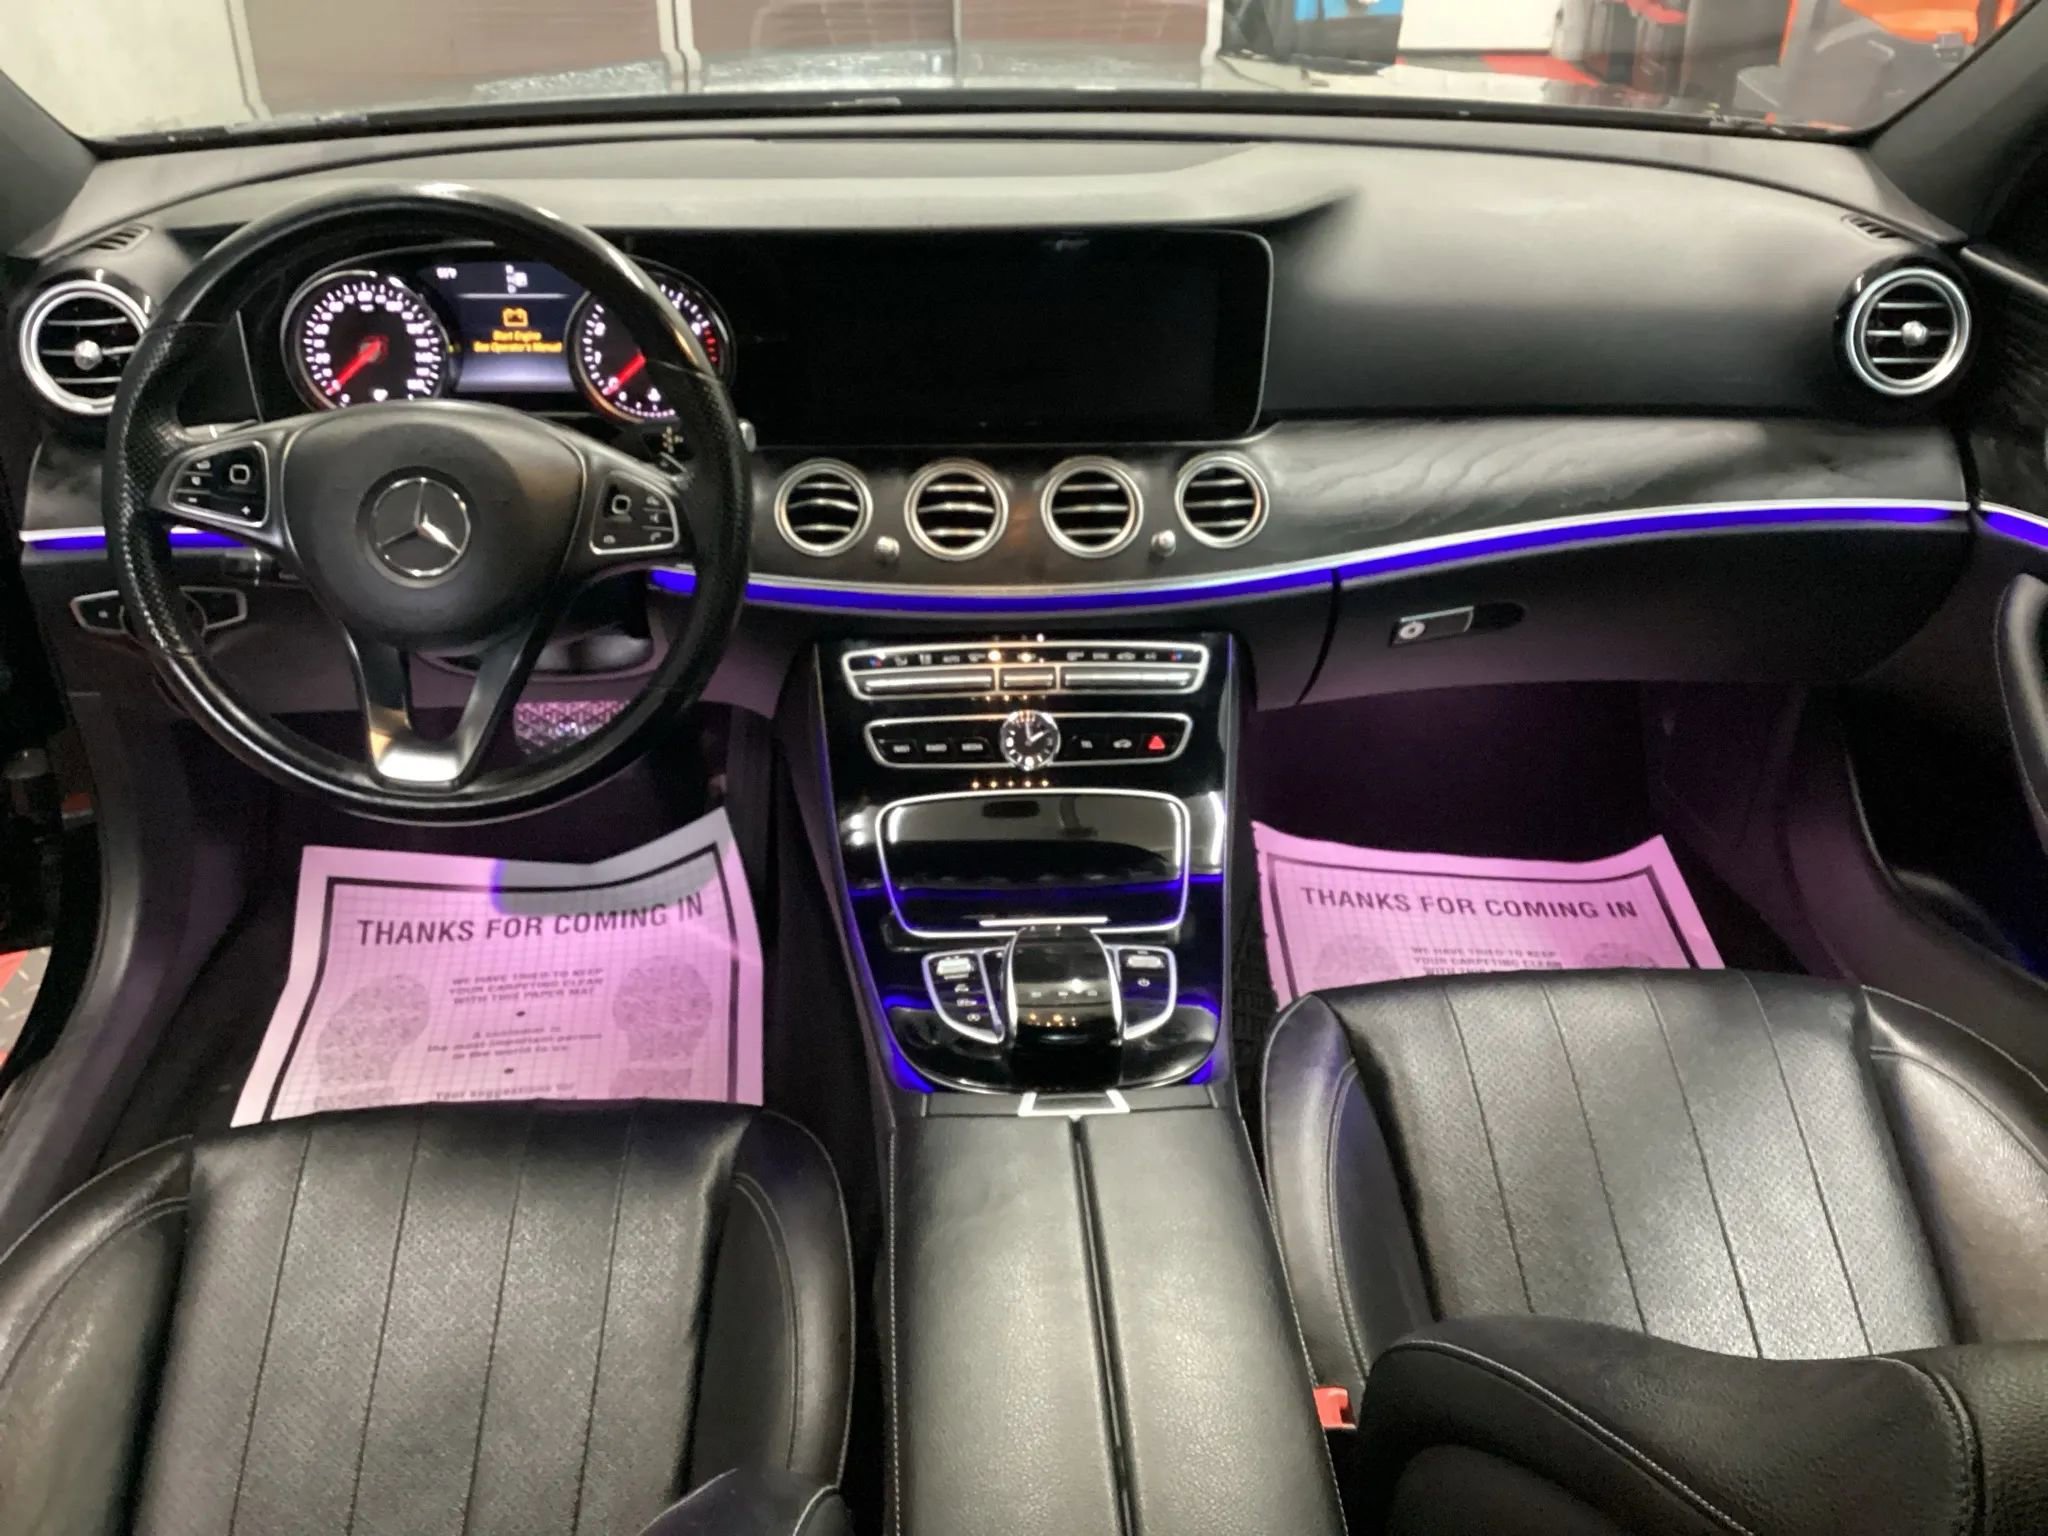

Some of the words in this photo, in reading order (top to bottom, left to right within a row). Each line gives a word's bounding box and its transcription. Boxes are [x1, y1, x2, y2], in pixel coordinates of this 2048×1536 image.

[357, 919, 475, 946] THANKS
[486, 916, 543, 939] FOR
[554, 903, 667, 935] COMING
[677, 892, 704, 922] IN
[1301, 887, 1411, 913] THANKS
[1420, 896, 1476, 915] FOR
[1485, 899, 1599, 919] COMING
[1606, 901, 1638, 918] IN
